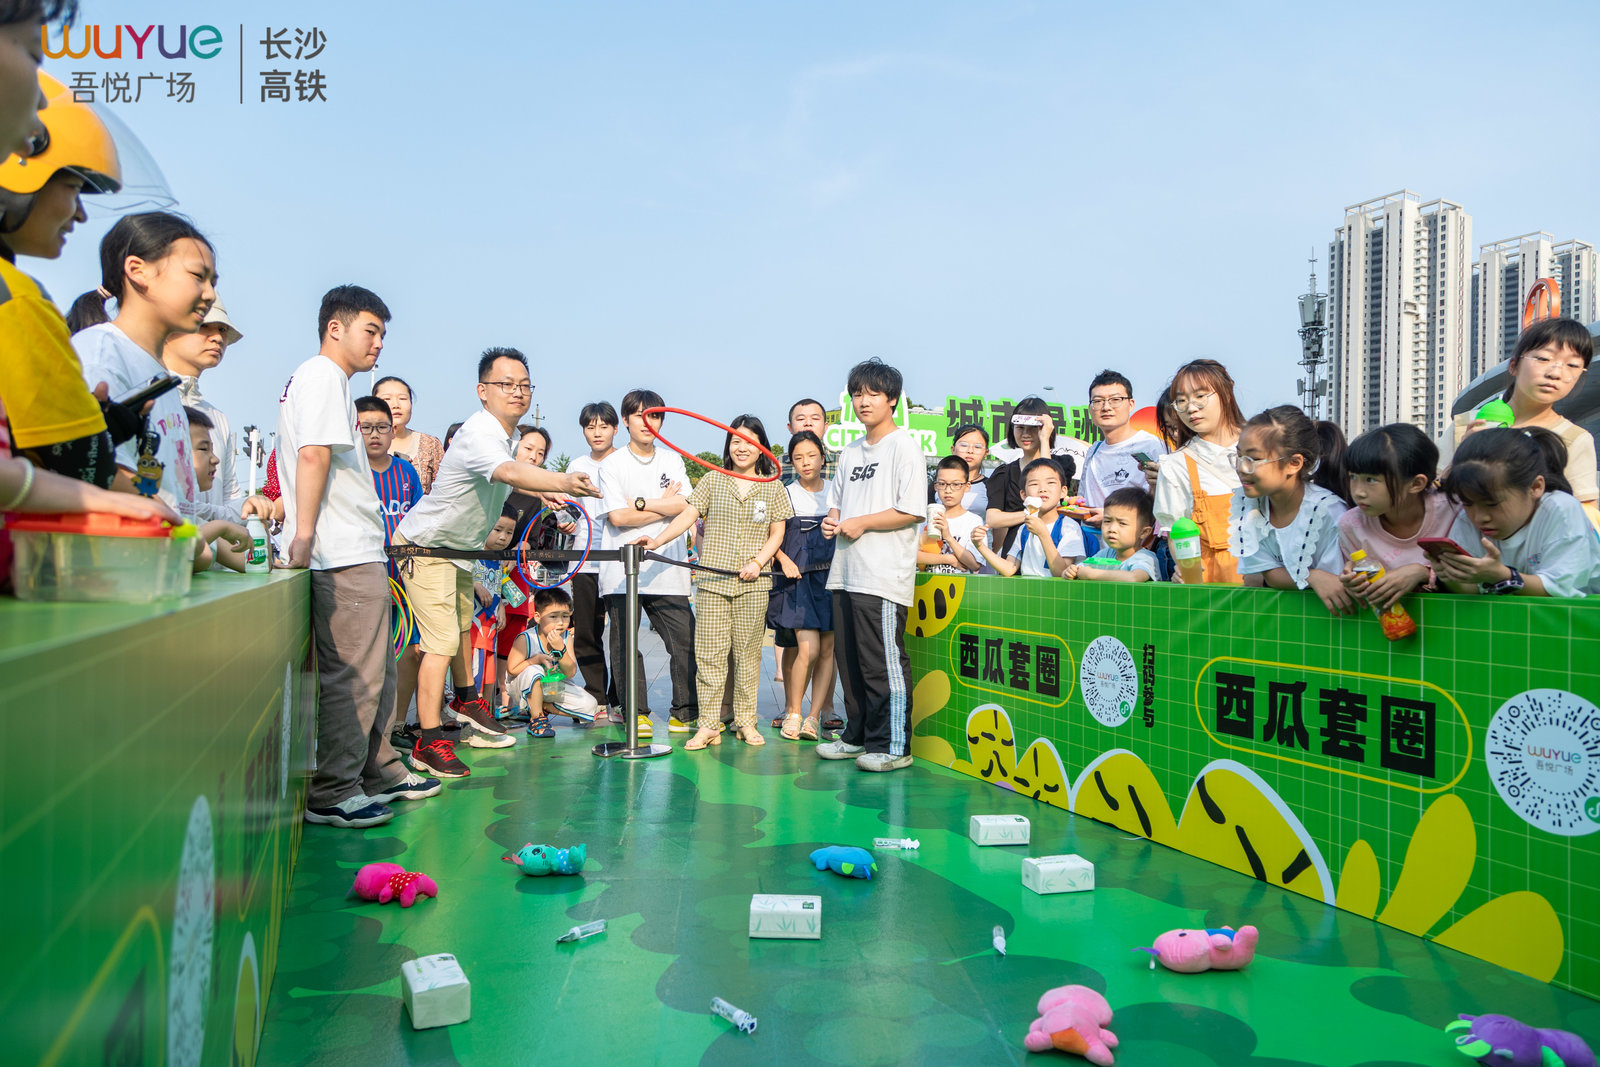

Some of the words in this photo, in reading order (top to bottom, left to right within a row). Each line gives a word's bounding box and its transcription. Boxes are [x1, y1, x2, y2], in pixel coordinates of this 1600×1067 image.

[827, 428, 867, 448] CIT
[960, 633, 1060, 698] 西瓜套圈
[1215, 671, 1436, 779] 西瓜套圈
